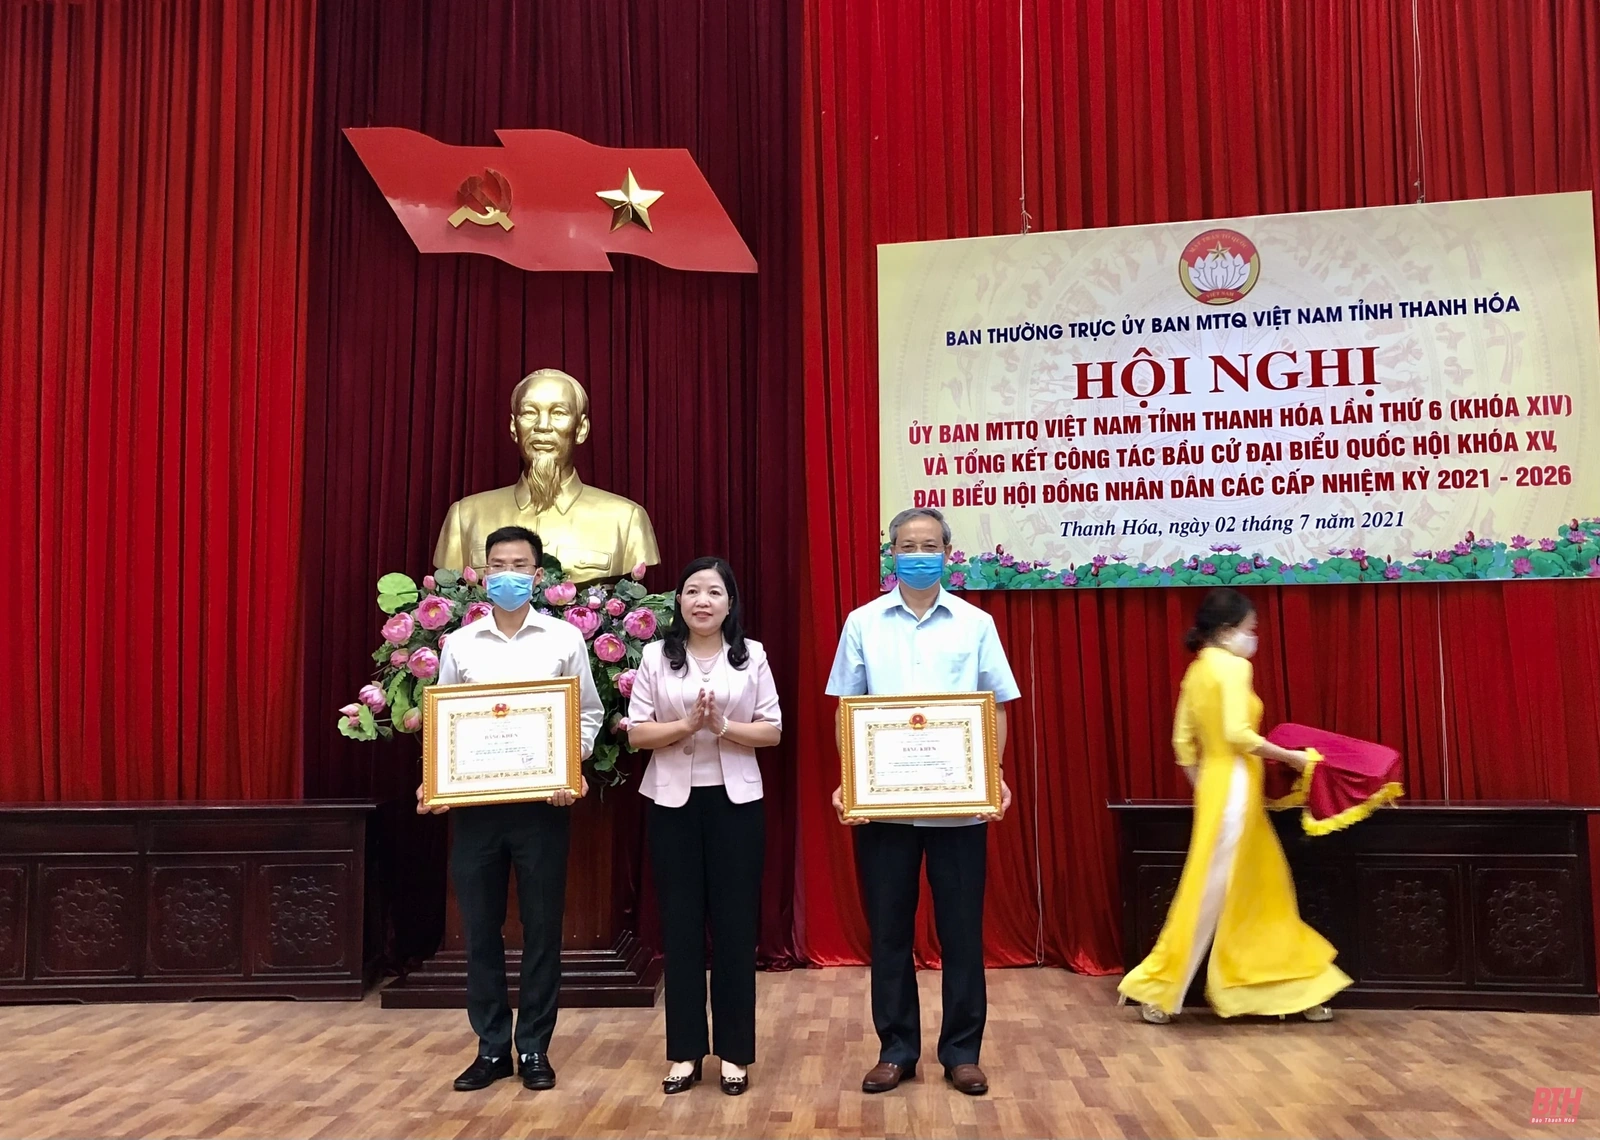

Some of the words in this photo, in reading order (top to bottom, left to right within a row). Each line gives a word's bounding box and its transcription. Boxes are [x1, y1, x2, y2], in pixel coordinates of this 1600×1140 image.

[946, 330, 982, 347] BAN
[988, 323, 1063, 344] THƯỜNG
[1069, 319, 1116, 342] TRỰC
[1122, 314, 1146, 335] ỦY
[1151, 315, 1190, 333] BAN
[1196, 312, 1248, 330] MTTQ
[1253, 305, 1292, 330] VIỆT
[1298, 306, 1343, 325] NAM
[1349, 299, 1393, 322] TỈNH
[1399, 299, 1467, 318] THANH
[1474, 292, 1520, 314] HÓA
[1072, 347, 1192, 408] HỘI
[1209, 346, 1382, 398] NGHỊ
[909, 420, 933, 445] ỦY
[939, 423, 979, 443] BAN
[986, 420, 1038, 442] MTTQ
[1045, 415, 1087, 441] VIỆT
[1094, 416, 1142, 436] NAM
[1148, 408, 1195, 433] TỈNH
[1202, 409, 1273, 430] THANH
[1280, 402, 1323, 427] HÓA
[1330, 398, 1373, 425] LẦN
[1380, 399, 1423, 422] THỨ
[1428, 400, 1442, 420] 6
[1450, 393, 1520, 422] (KHÓA
[1527, 394, 1573, 417] XIV)
[924, 453, 948, 476] VÀ
[954, 448, 1005, 474] TỔNG
[1011, 446, 1048, 472] KẾT
[1054, 447, 1110, 470] CÔNG
[1116, 445, 1155, 468] TÁC
[1162, 439, 1202, 466] BẦU
[1212, 436, 1241, 463] CỬ
[1246, 442, 1282, 466] ĐẠI
[1289, 432, 1339, 461] BIỂU
[1349, 430, 1405, 459] QUỐC
[1413, 430, 1450, 459] HỘI
[1457, 429, 1519, 455] KHÓA
[1526, 430, 1557, 453] XV,
[952, 480, 997, 507] BIỂU
[1003, 482, 1036, 508] HỘI
[1042, 478, 1099, 503] ĐỒNG
[1105, 477, 1164, 501] NHÂN
[1170, 474, 1214, 499] DÂN
[1221, 473, 1264, 497] CÁC
[1271, 468, 1315, 495] CẤP
[1322, 469, 1395, 496] NHIỆM
[1402, 466, 1430, 491] KỲ
[1437, 468, 1490, 490] 2021
[1515, 465, 1572, 487] 2026
[1059, 521, 1115, 538] Thanh
[1122, 518, 1162, 537] Hóa,
[1168, 519, 1210, 538] ngày
[1215, 517, 1236, 533] 02
[1241, 514, 1293, 535] tháng
[1300, 514, 1310, 530] 7
[1315, 513, 1356, 530] năm
[1361, 511, 1405, 529] 2021
